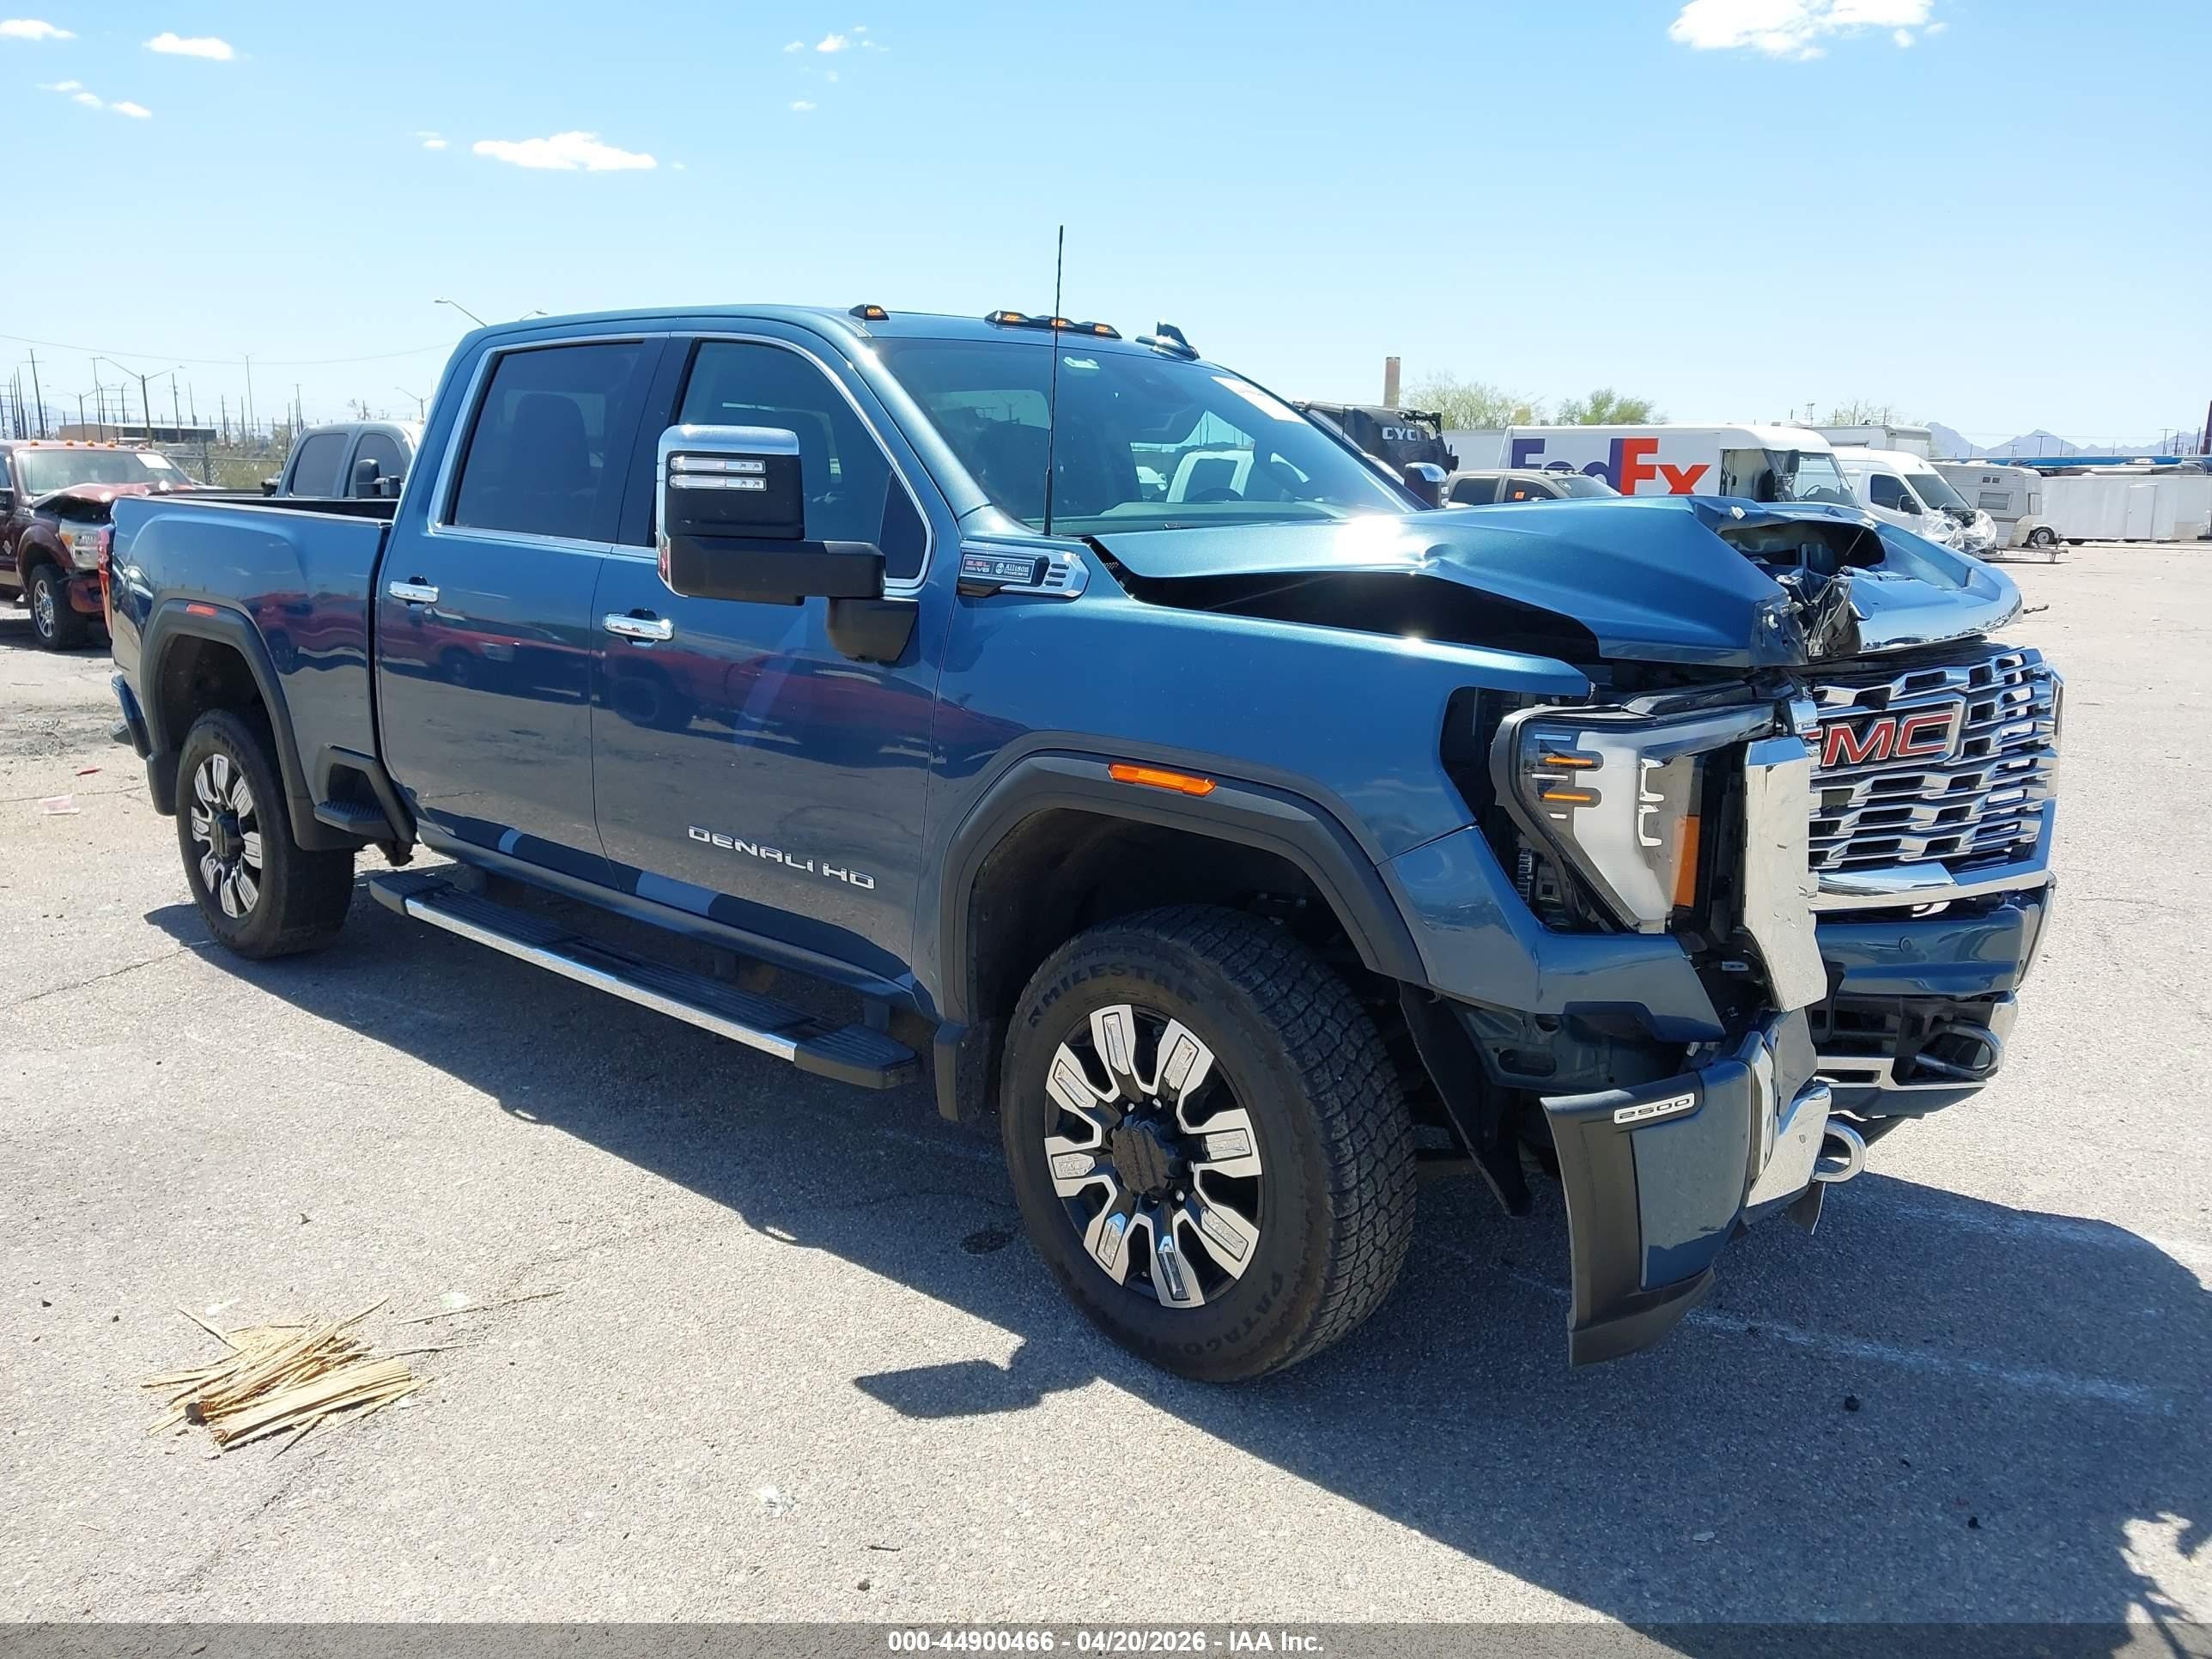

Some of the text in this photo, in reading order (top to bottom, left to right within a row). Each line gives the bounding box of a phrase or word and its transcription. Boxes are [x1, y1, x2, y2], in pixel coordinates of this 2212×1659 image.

[1511, 438, 1711, 495] FdEx
[1805, 712, 1954, 767] MC
[688, 825, 875, 890] DENALI HD
[1617, 1097, 1690, 1119] 2500
